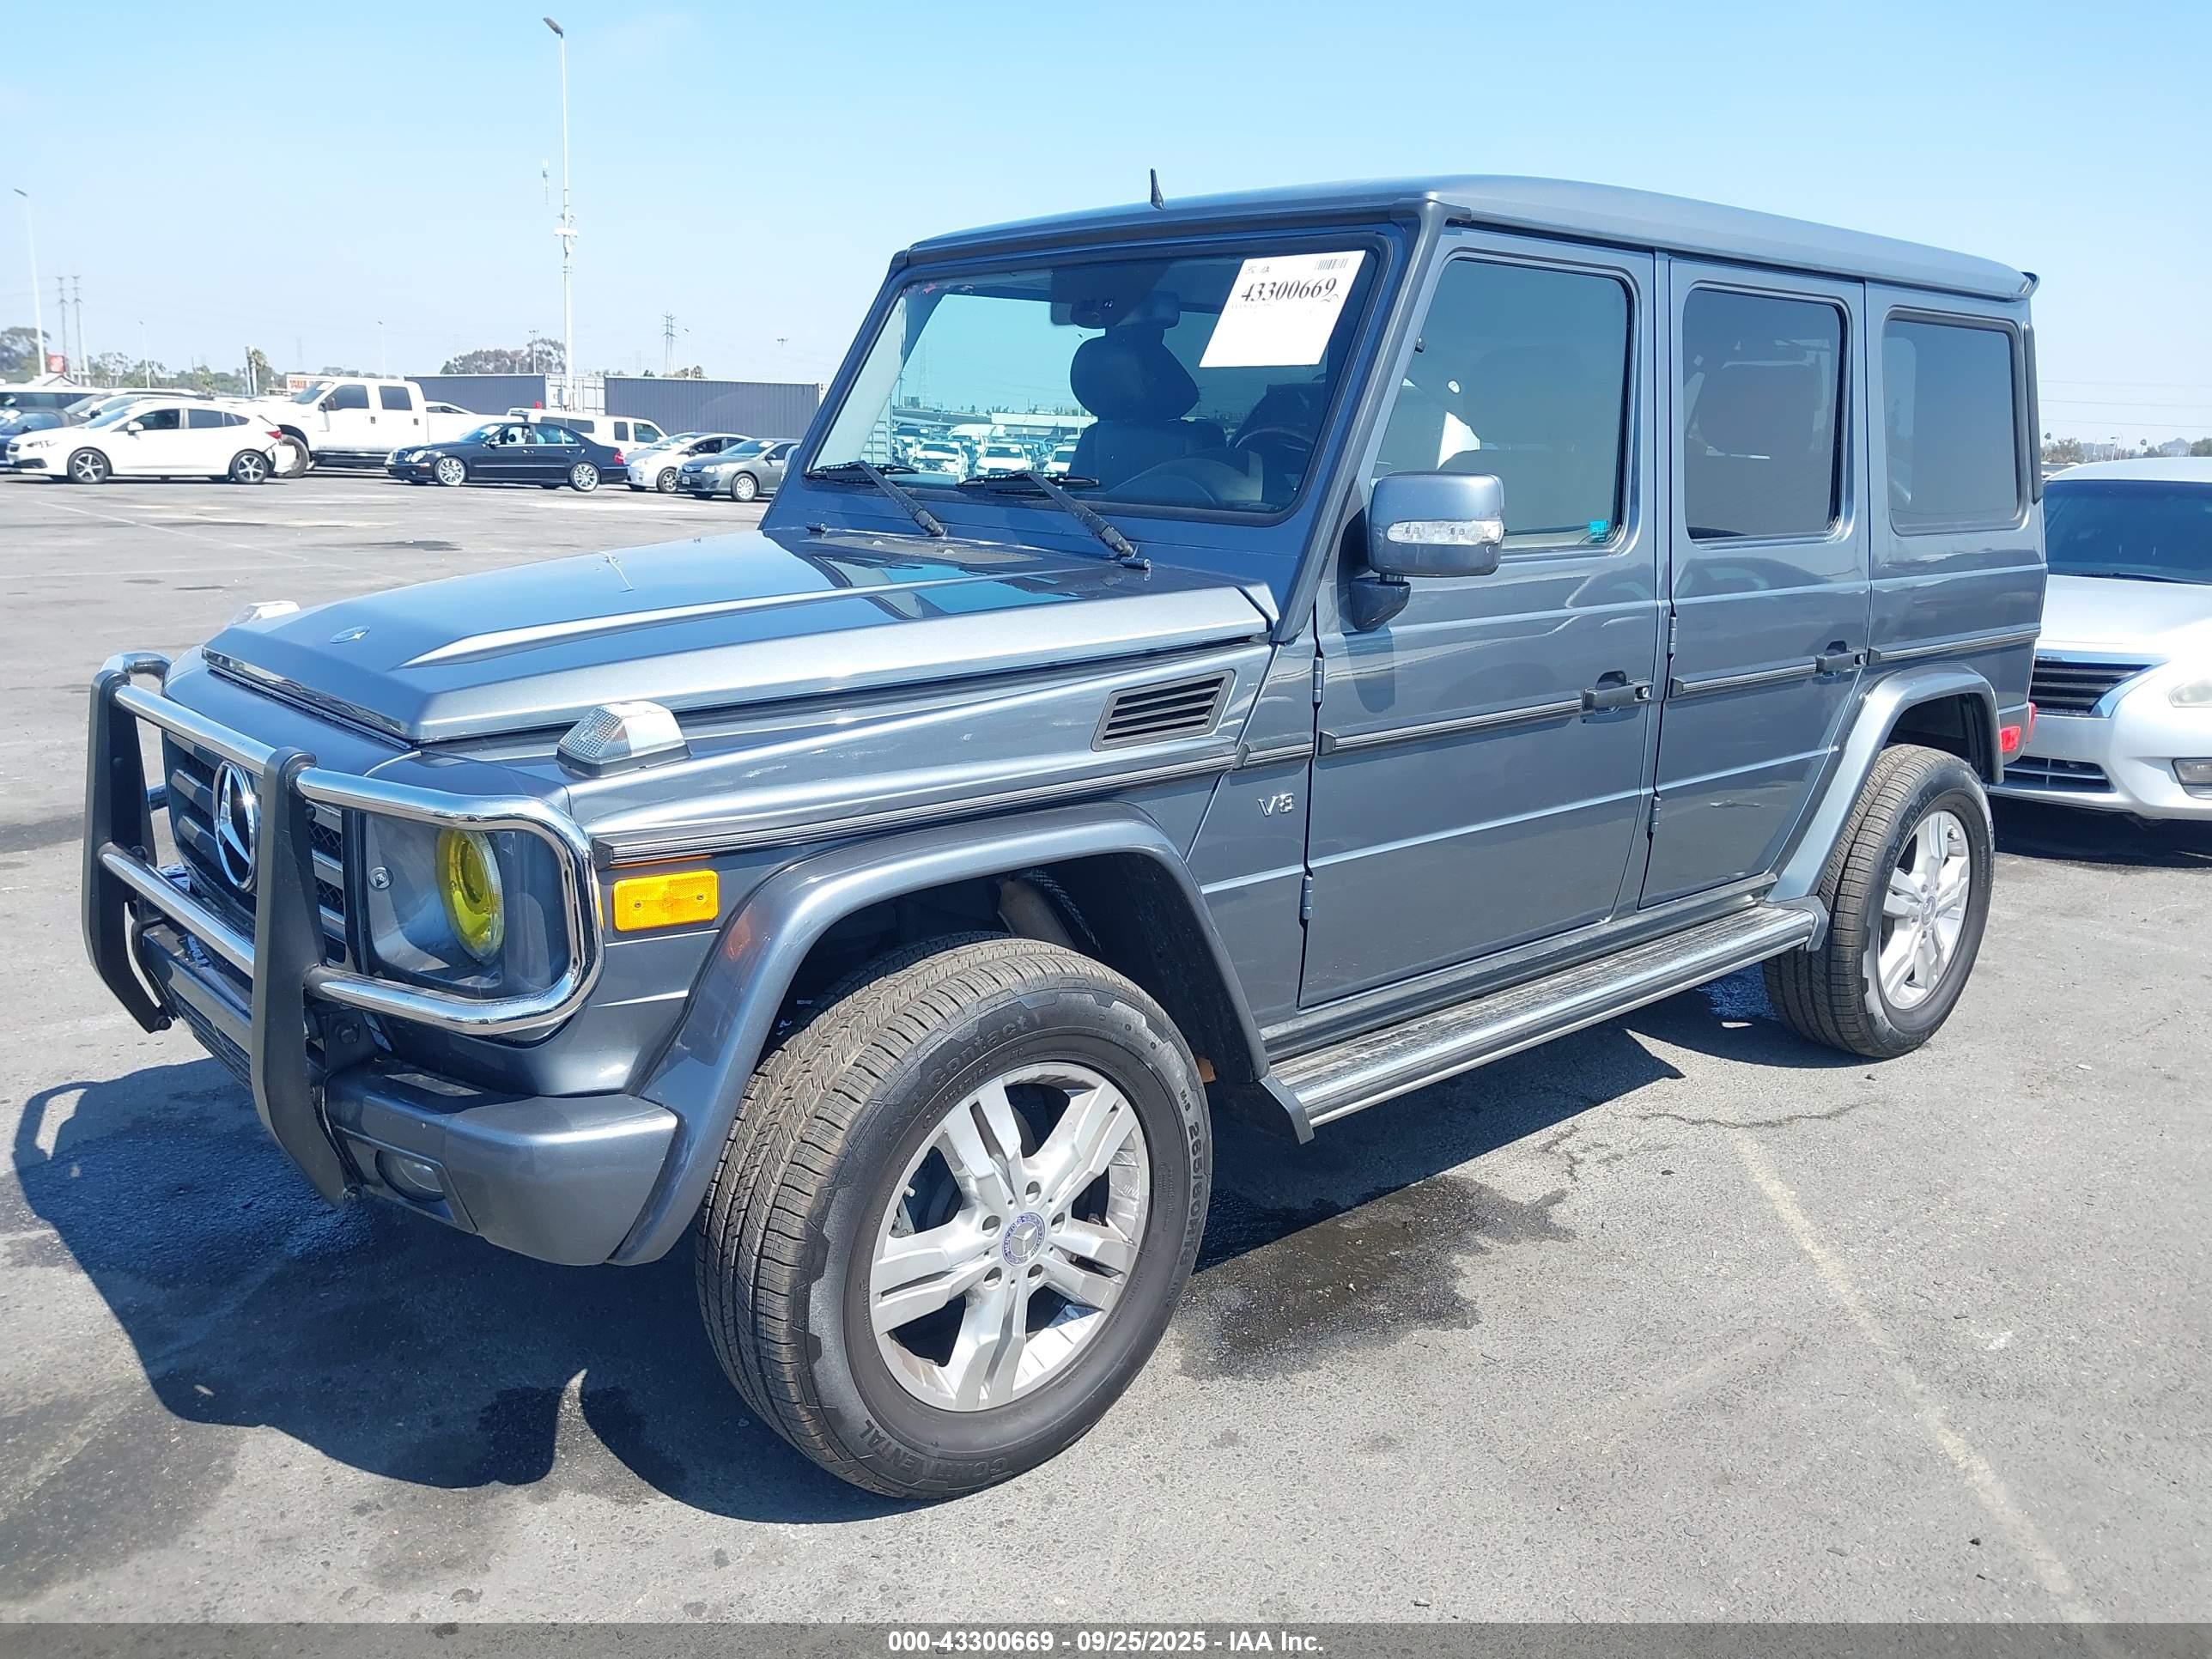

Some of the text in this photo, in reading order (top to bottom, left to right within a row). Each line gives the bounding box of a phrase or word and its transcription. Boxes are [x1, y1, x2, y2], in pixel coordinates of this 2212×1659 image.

[1241, 277, 1337, 302] 43300669
[1257, 792, 1294, 817] V8
[927, 1015, 1029, 1087] Contact
